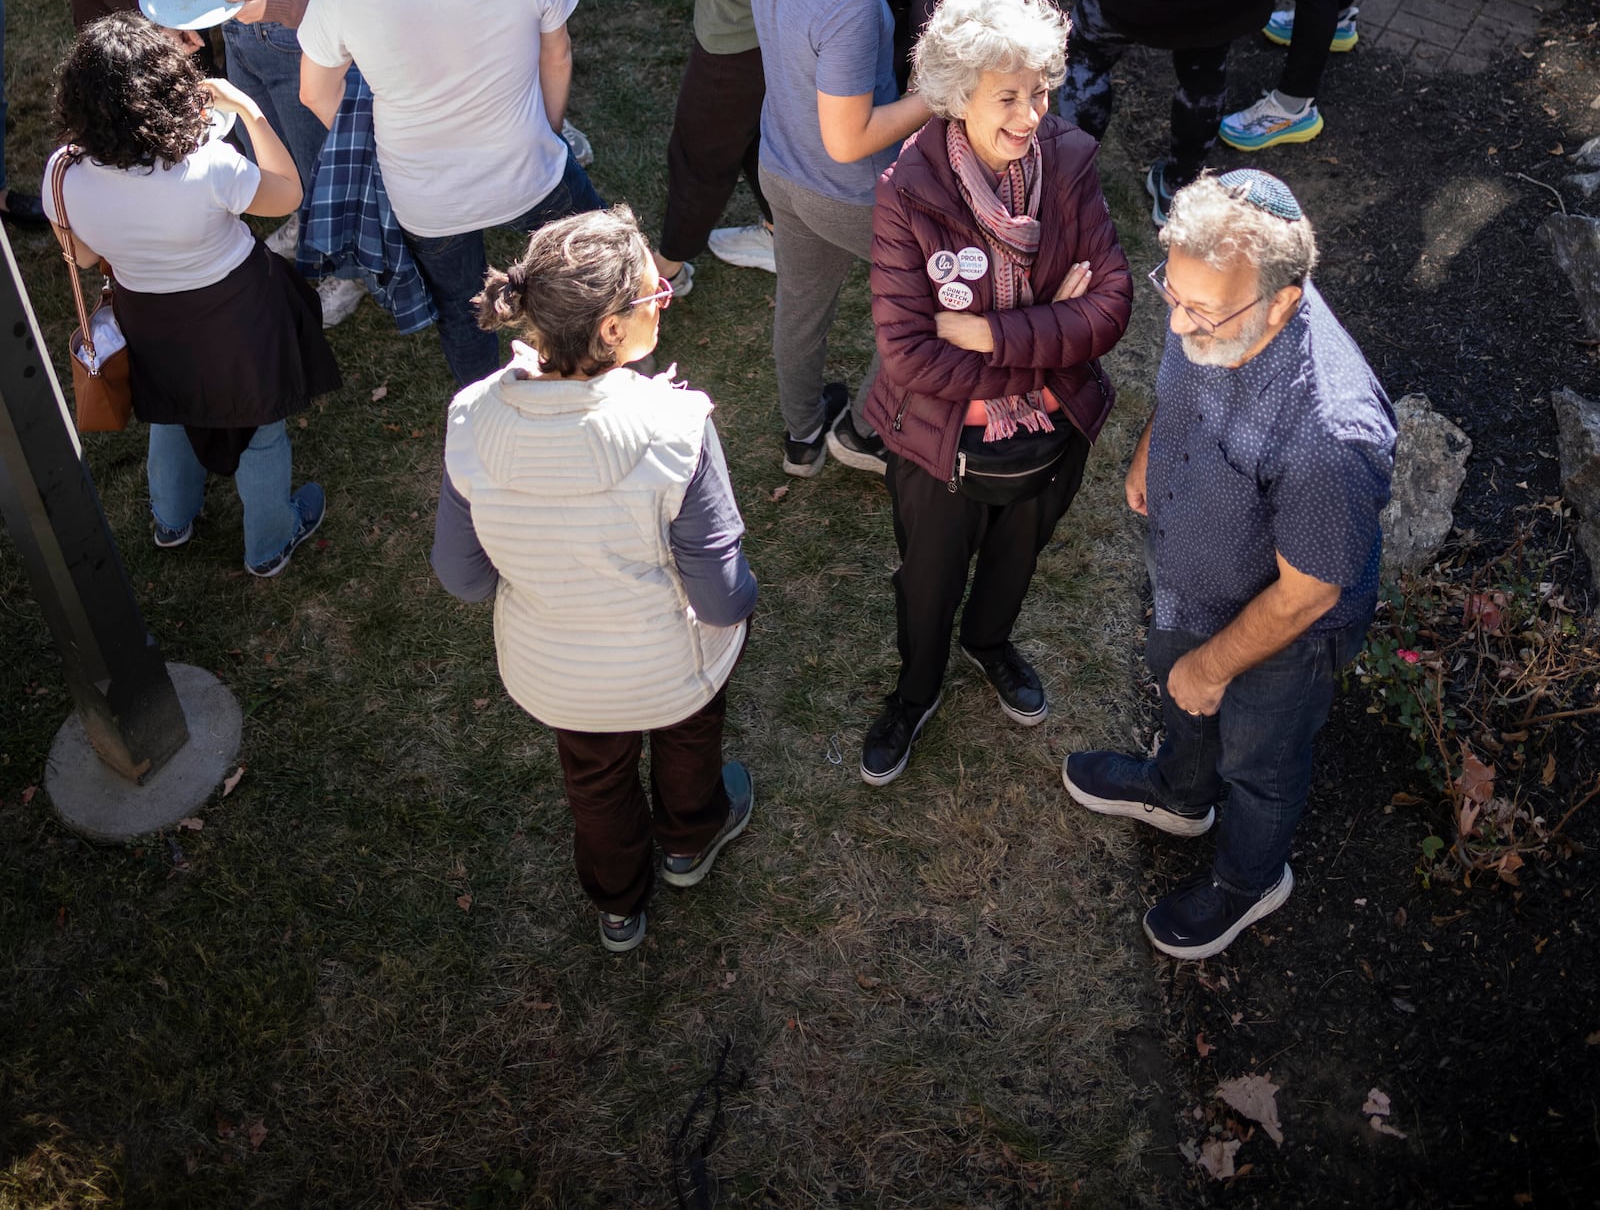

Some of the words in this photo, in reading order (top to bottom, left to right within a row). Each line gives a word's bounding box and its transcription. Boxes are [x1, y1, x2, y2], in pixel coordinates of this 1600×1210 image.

[946, 286, 968, 297] DON'T
[941, 291, 970, 304] KVETCH,
[944, 296, 964, 307] VOTE!
